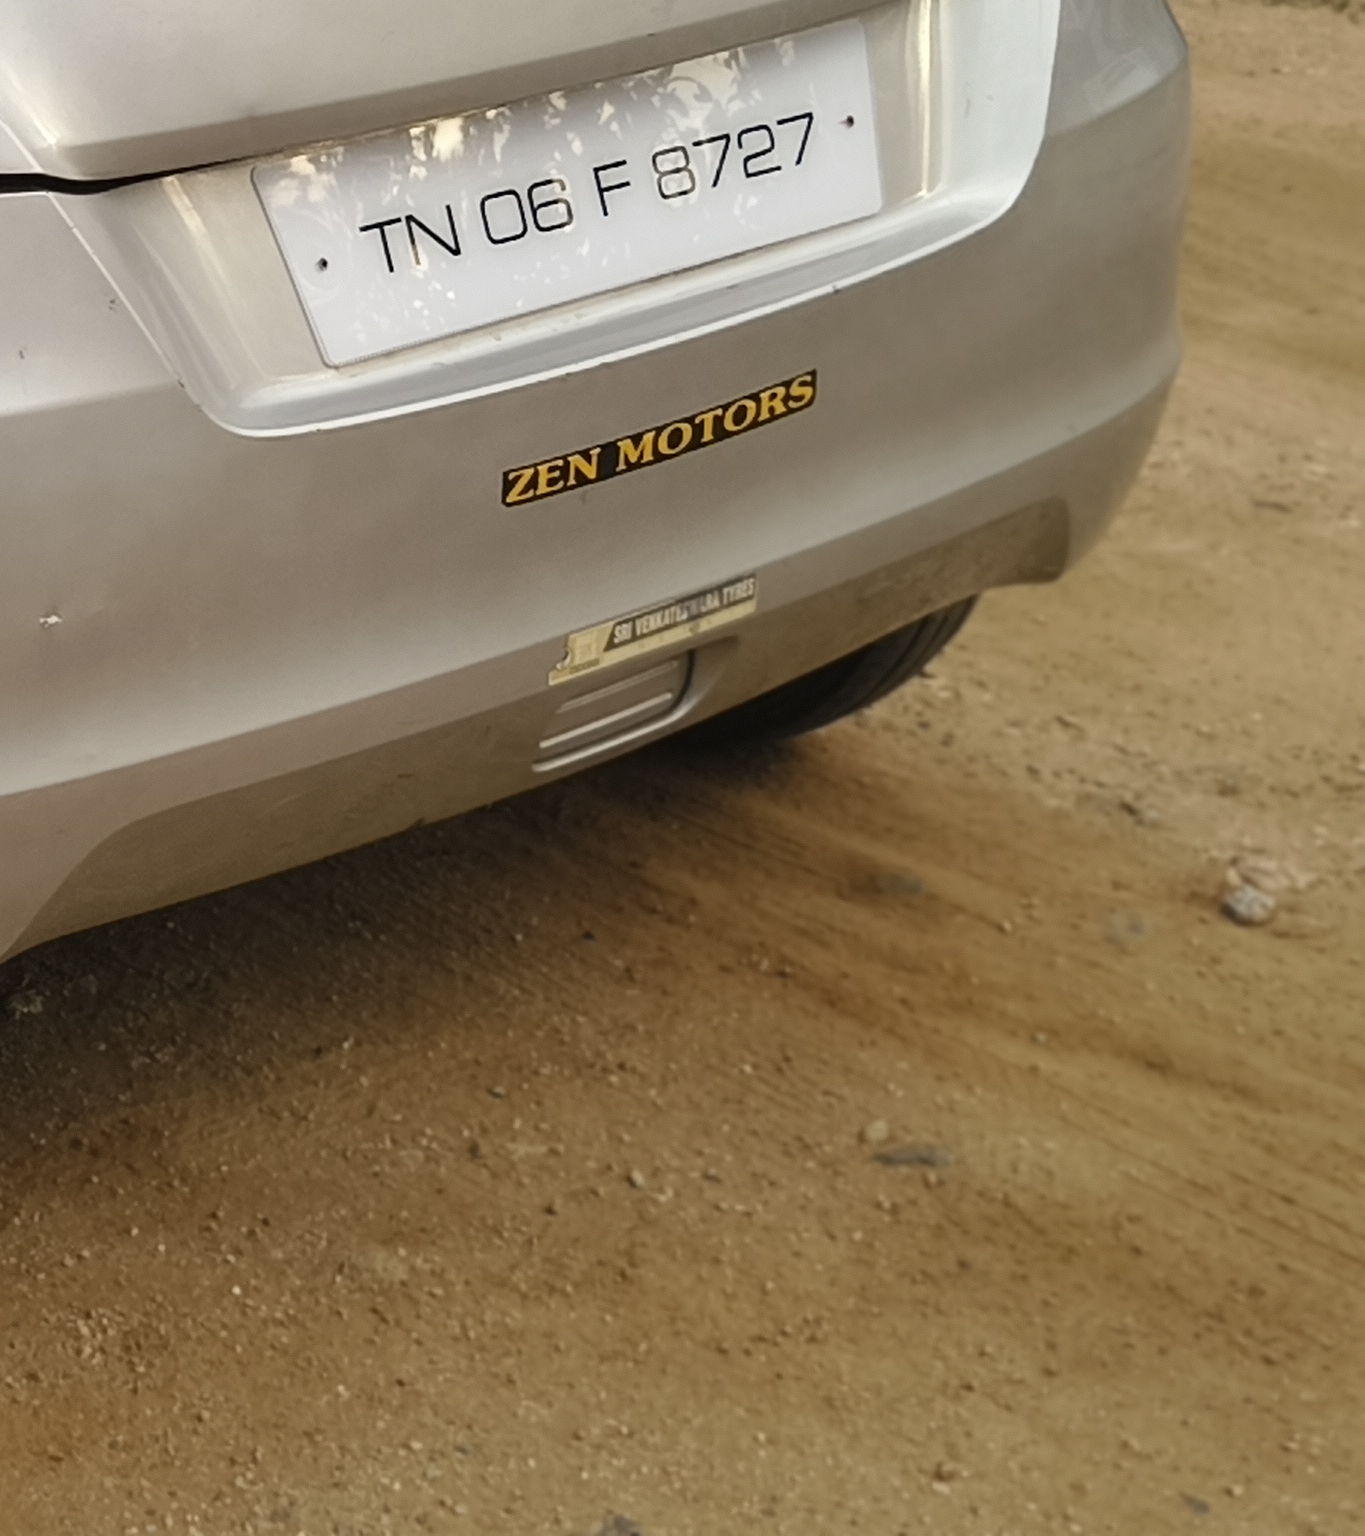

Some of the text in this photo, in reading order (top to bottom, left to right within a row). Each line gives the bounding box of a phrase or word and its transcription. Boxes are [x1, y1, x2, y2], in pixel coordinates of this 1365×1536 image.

[359, 111, 815, 273] TN 06 F 8727
[505, 373, 815, 504] ZEN MOTORS
[722, 577, 756, 605] TYRES
